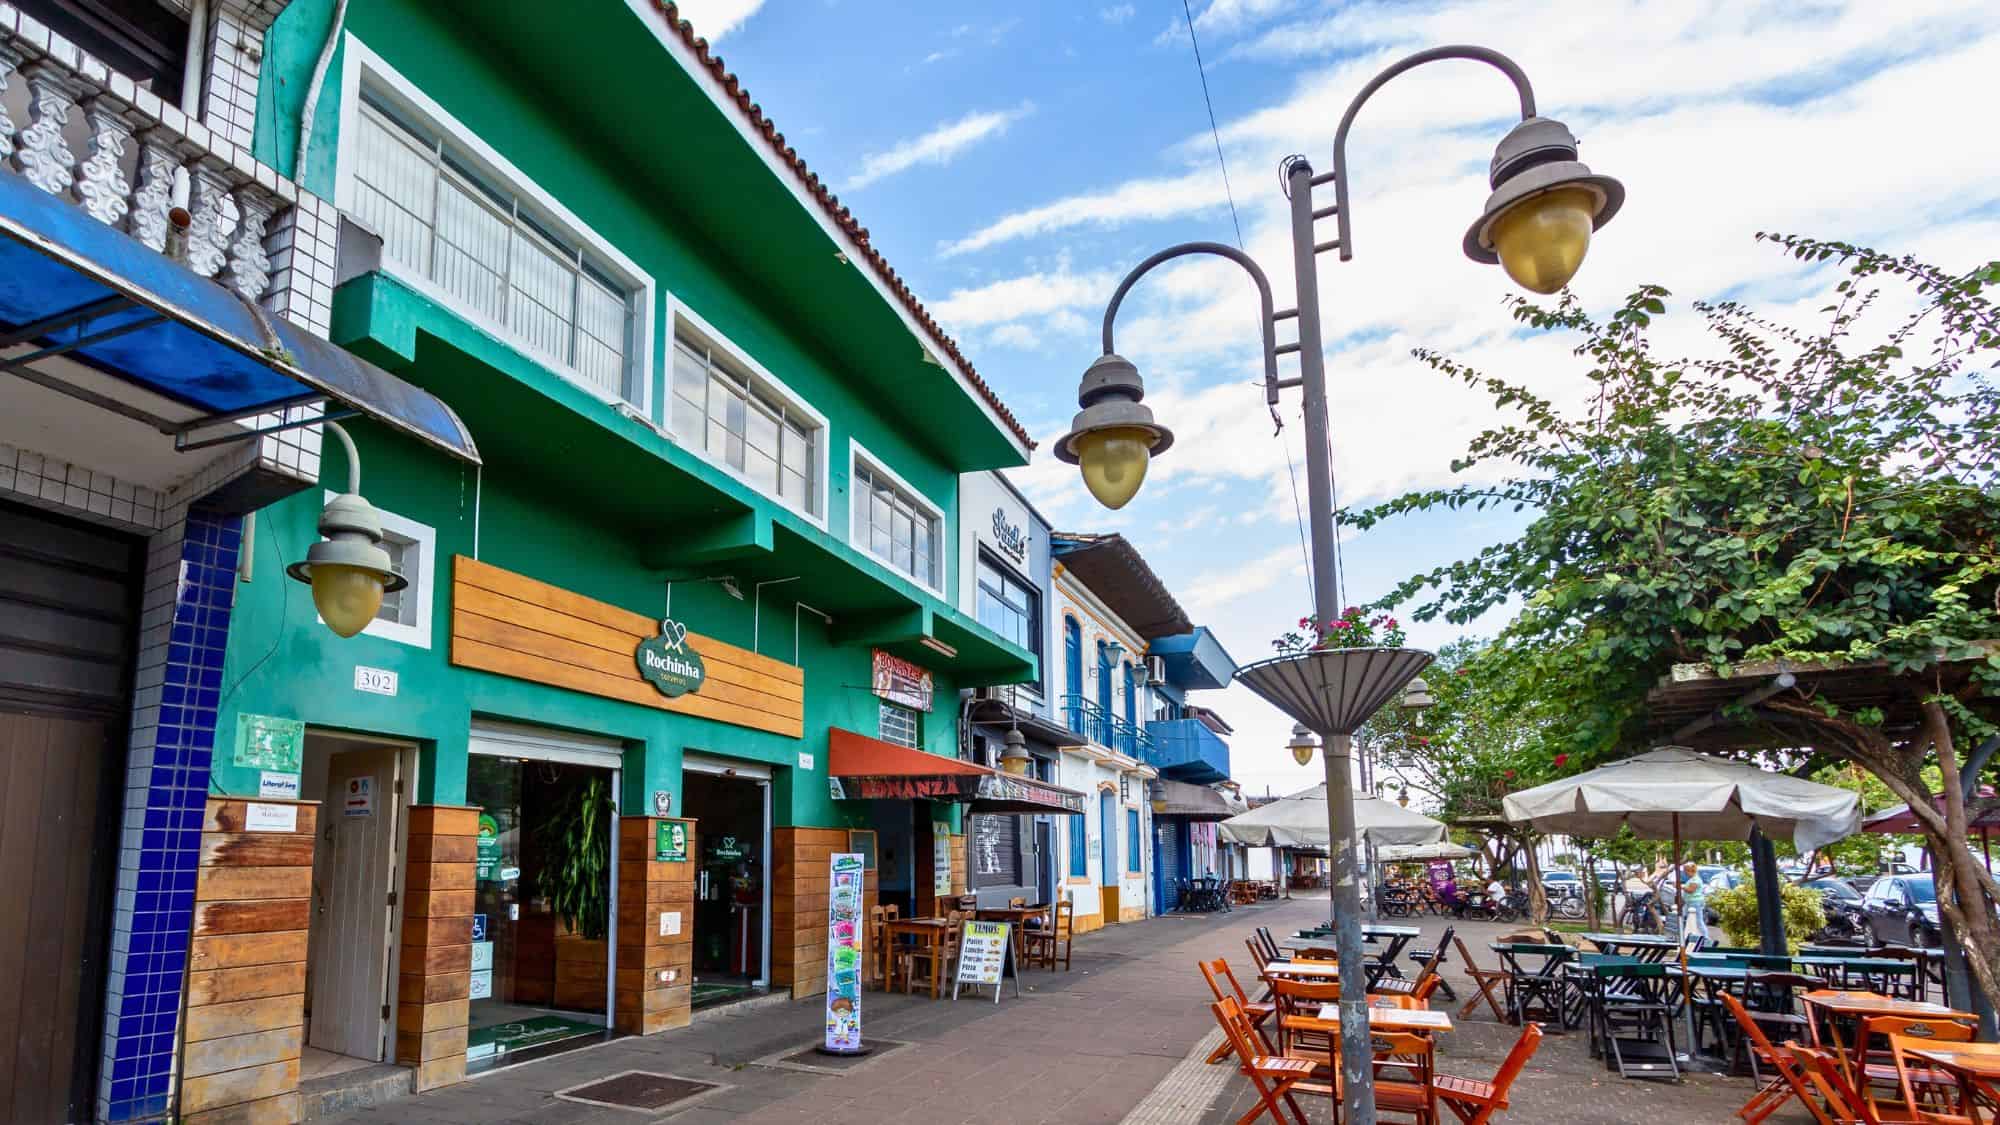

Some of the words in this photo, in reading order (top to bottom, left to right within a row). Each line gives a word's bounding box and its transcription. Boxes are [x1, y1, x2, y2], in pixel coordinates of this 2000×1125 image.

[646, 649, 699, 679] Rochinha
[359, 672, 391, 690] 302
[862, 780, 960, 798] BONANZA
